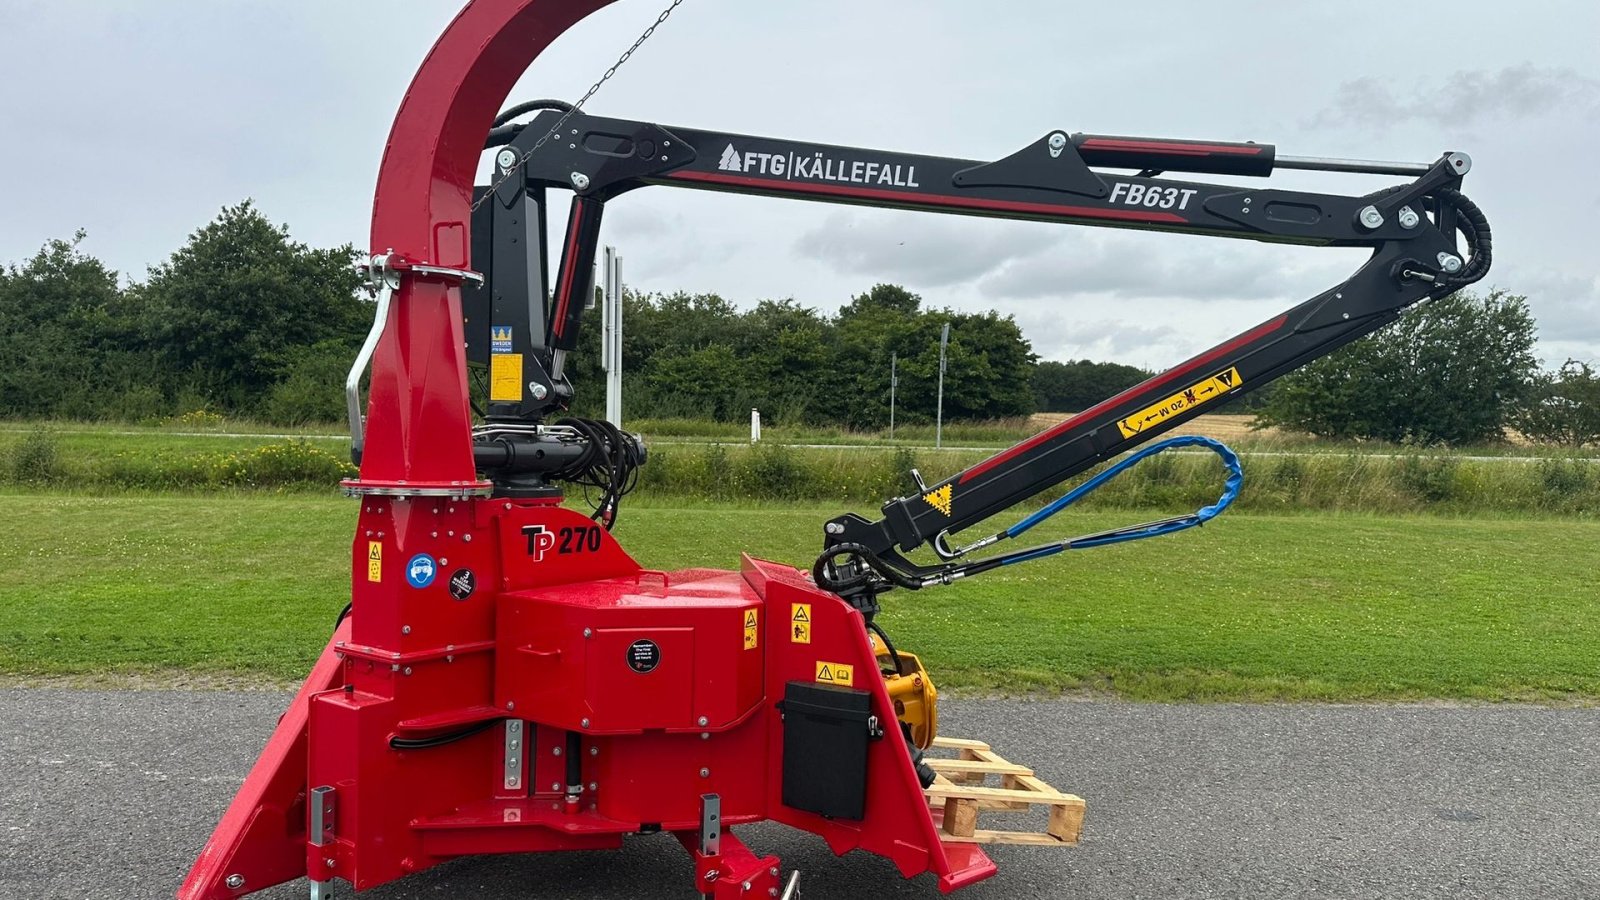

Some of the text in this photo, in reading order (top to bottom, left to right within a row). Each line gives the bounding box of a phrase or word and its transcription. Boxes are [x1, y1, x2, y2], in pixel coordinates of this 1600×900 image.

[743, 152, 919, 188] FTG KÄLLEFALL
[1109, 182, 1198, 210] FB63T
[1159, 400, 1184, 417] 20 M
[559, 526, 601, 555] 270
